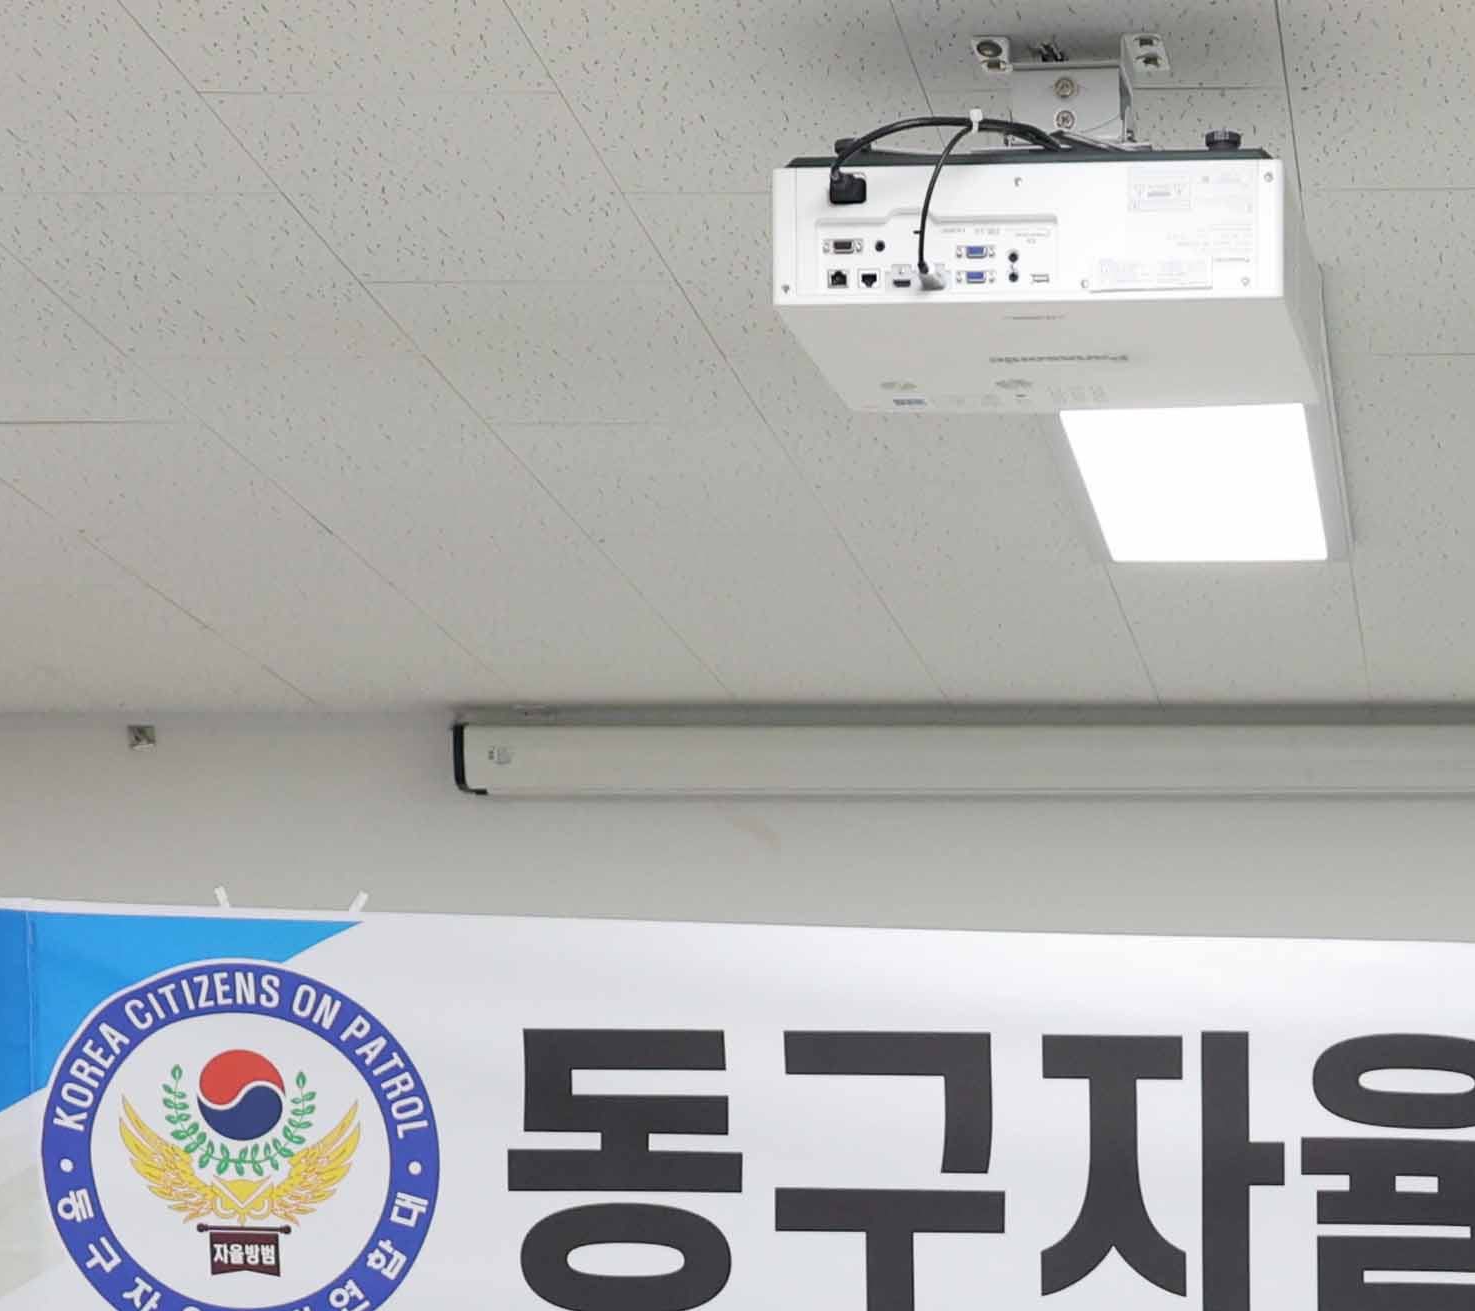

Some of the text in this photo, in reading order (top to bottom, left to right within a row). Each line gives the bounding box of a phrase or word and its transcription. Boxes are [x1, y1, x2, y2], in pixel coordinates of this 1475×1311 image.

[53, 971, 428, 1140] KOREA CITIZENS ON PATROL
[212, 1242, 276, 1266] 자율방범
